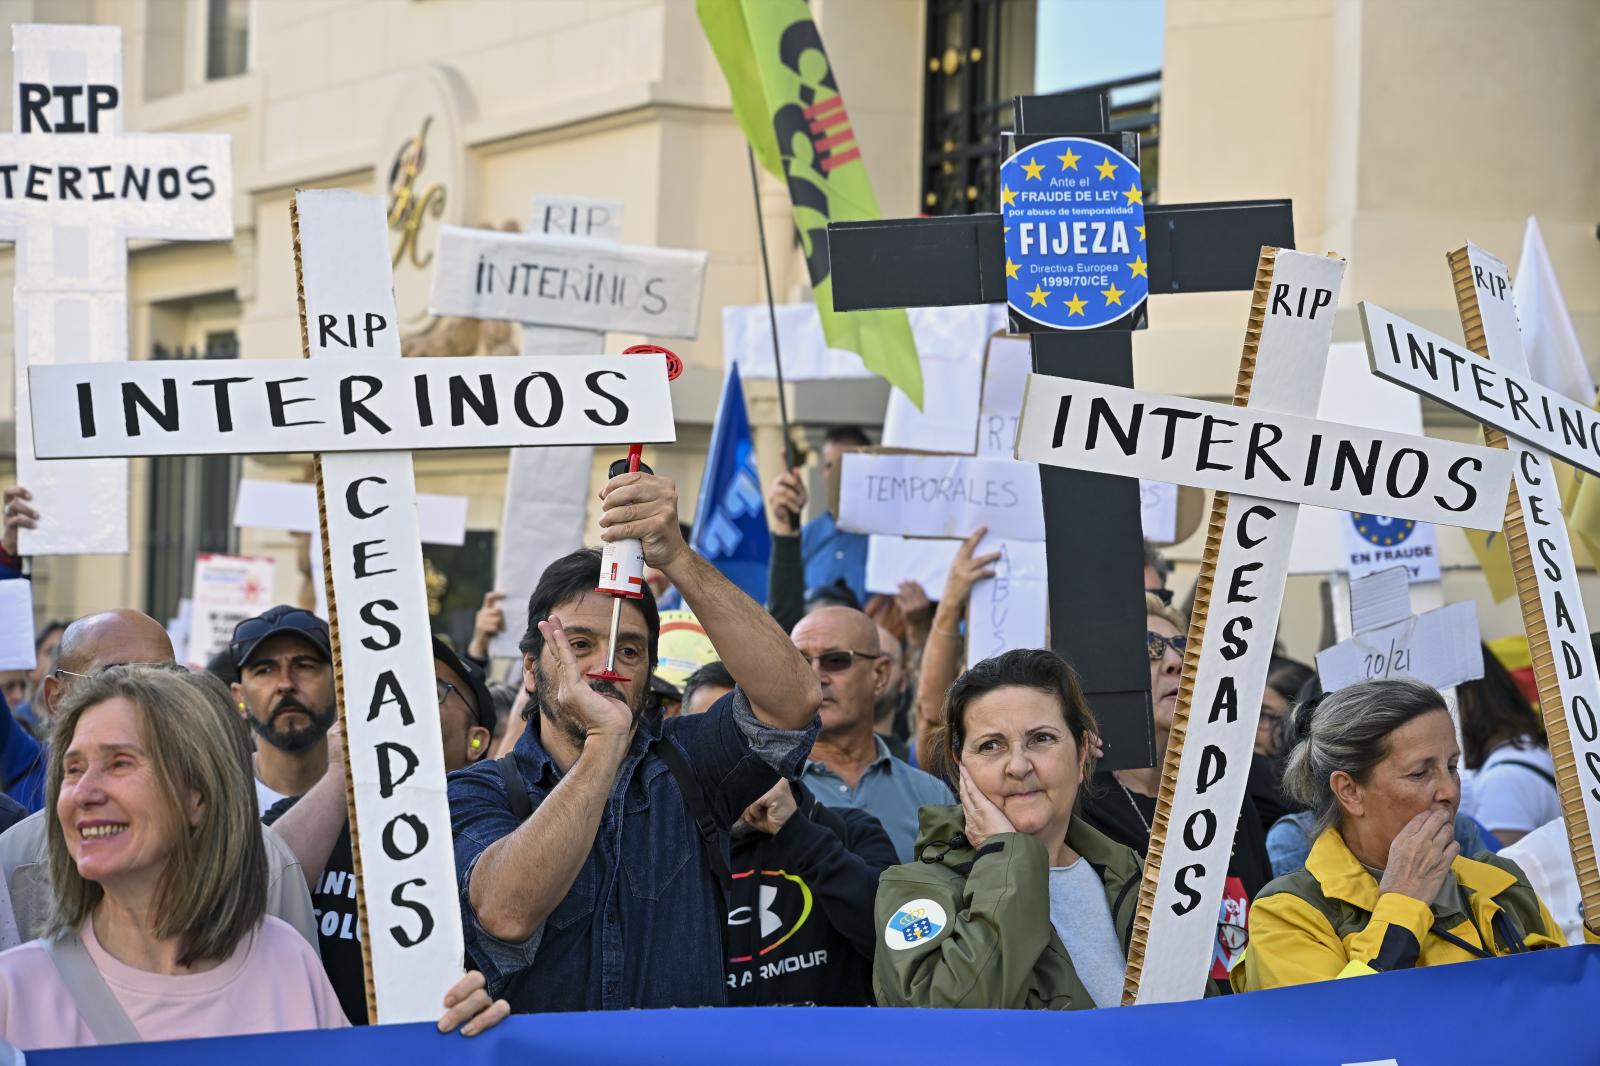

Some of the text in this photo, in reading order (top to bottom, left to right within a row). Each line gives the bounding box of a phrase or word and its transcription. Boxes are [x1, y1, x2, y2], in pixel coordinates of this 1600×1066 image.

[19, 82, 119, 134] RIP
[0, 164, 216, 202] TERINOS
[1021, 190, 1119, 202] FRAUDE DE LEY
[1049, 177, 1090, 188] Ante el
[543, 204, 611, 236] RIP
[1008, 206, 1134, 218] por abuso de temporalidad
[1019, 220, 1130, 256] FIJEZA
[1030, 262, 1119, 274] Directiva Europea
[1041, 275, 1109, 288] 1999/70/CE
[1473, 264, 1508, 301] RIP
[1271, 283, 1333, 320] RIP
[318, 312, 388, 349] RIP
[76, 370, 631, 438] INTERINOS
[1051, 394, 1484, 513] INTERINOS
[865, 474, 1019, 509] TEMPORALES
[1351, 545, 1432, 564] EN FRAUDE
[345, 476, 434, 948] CESADOS
[1171, 505, 1276, 917] CESADOS
